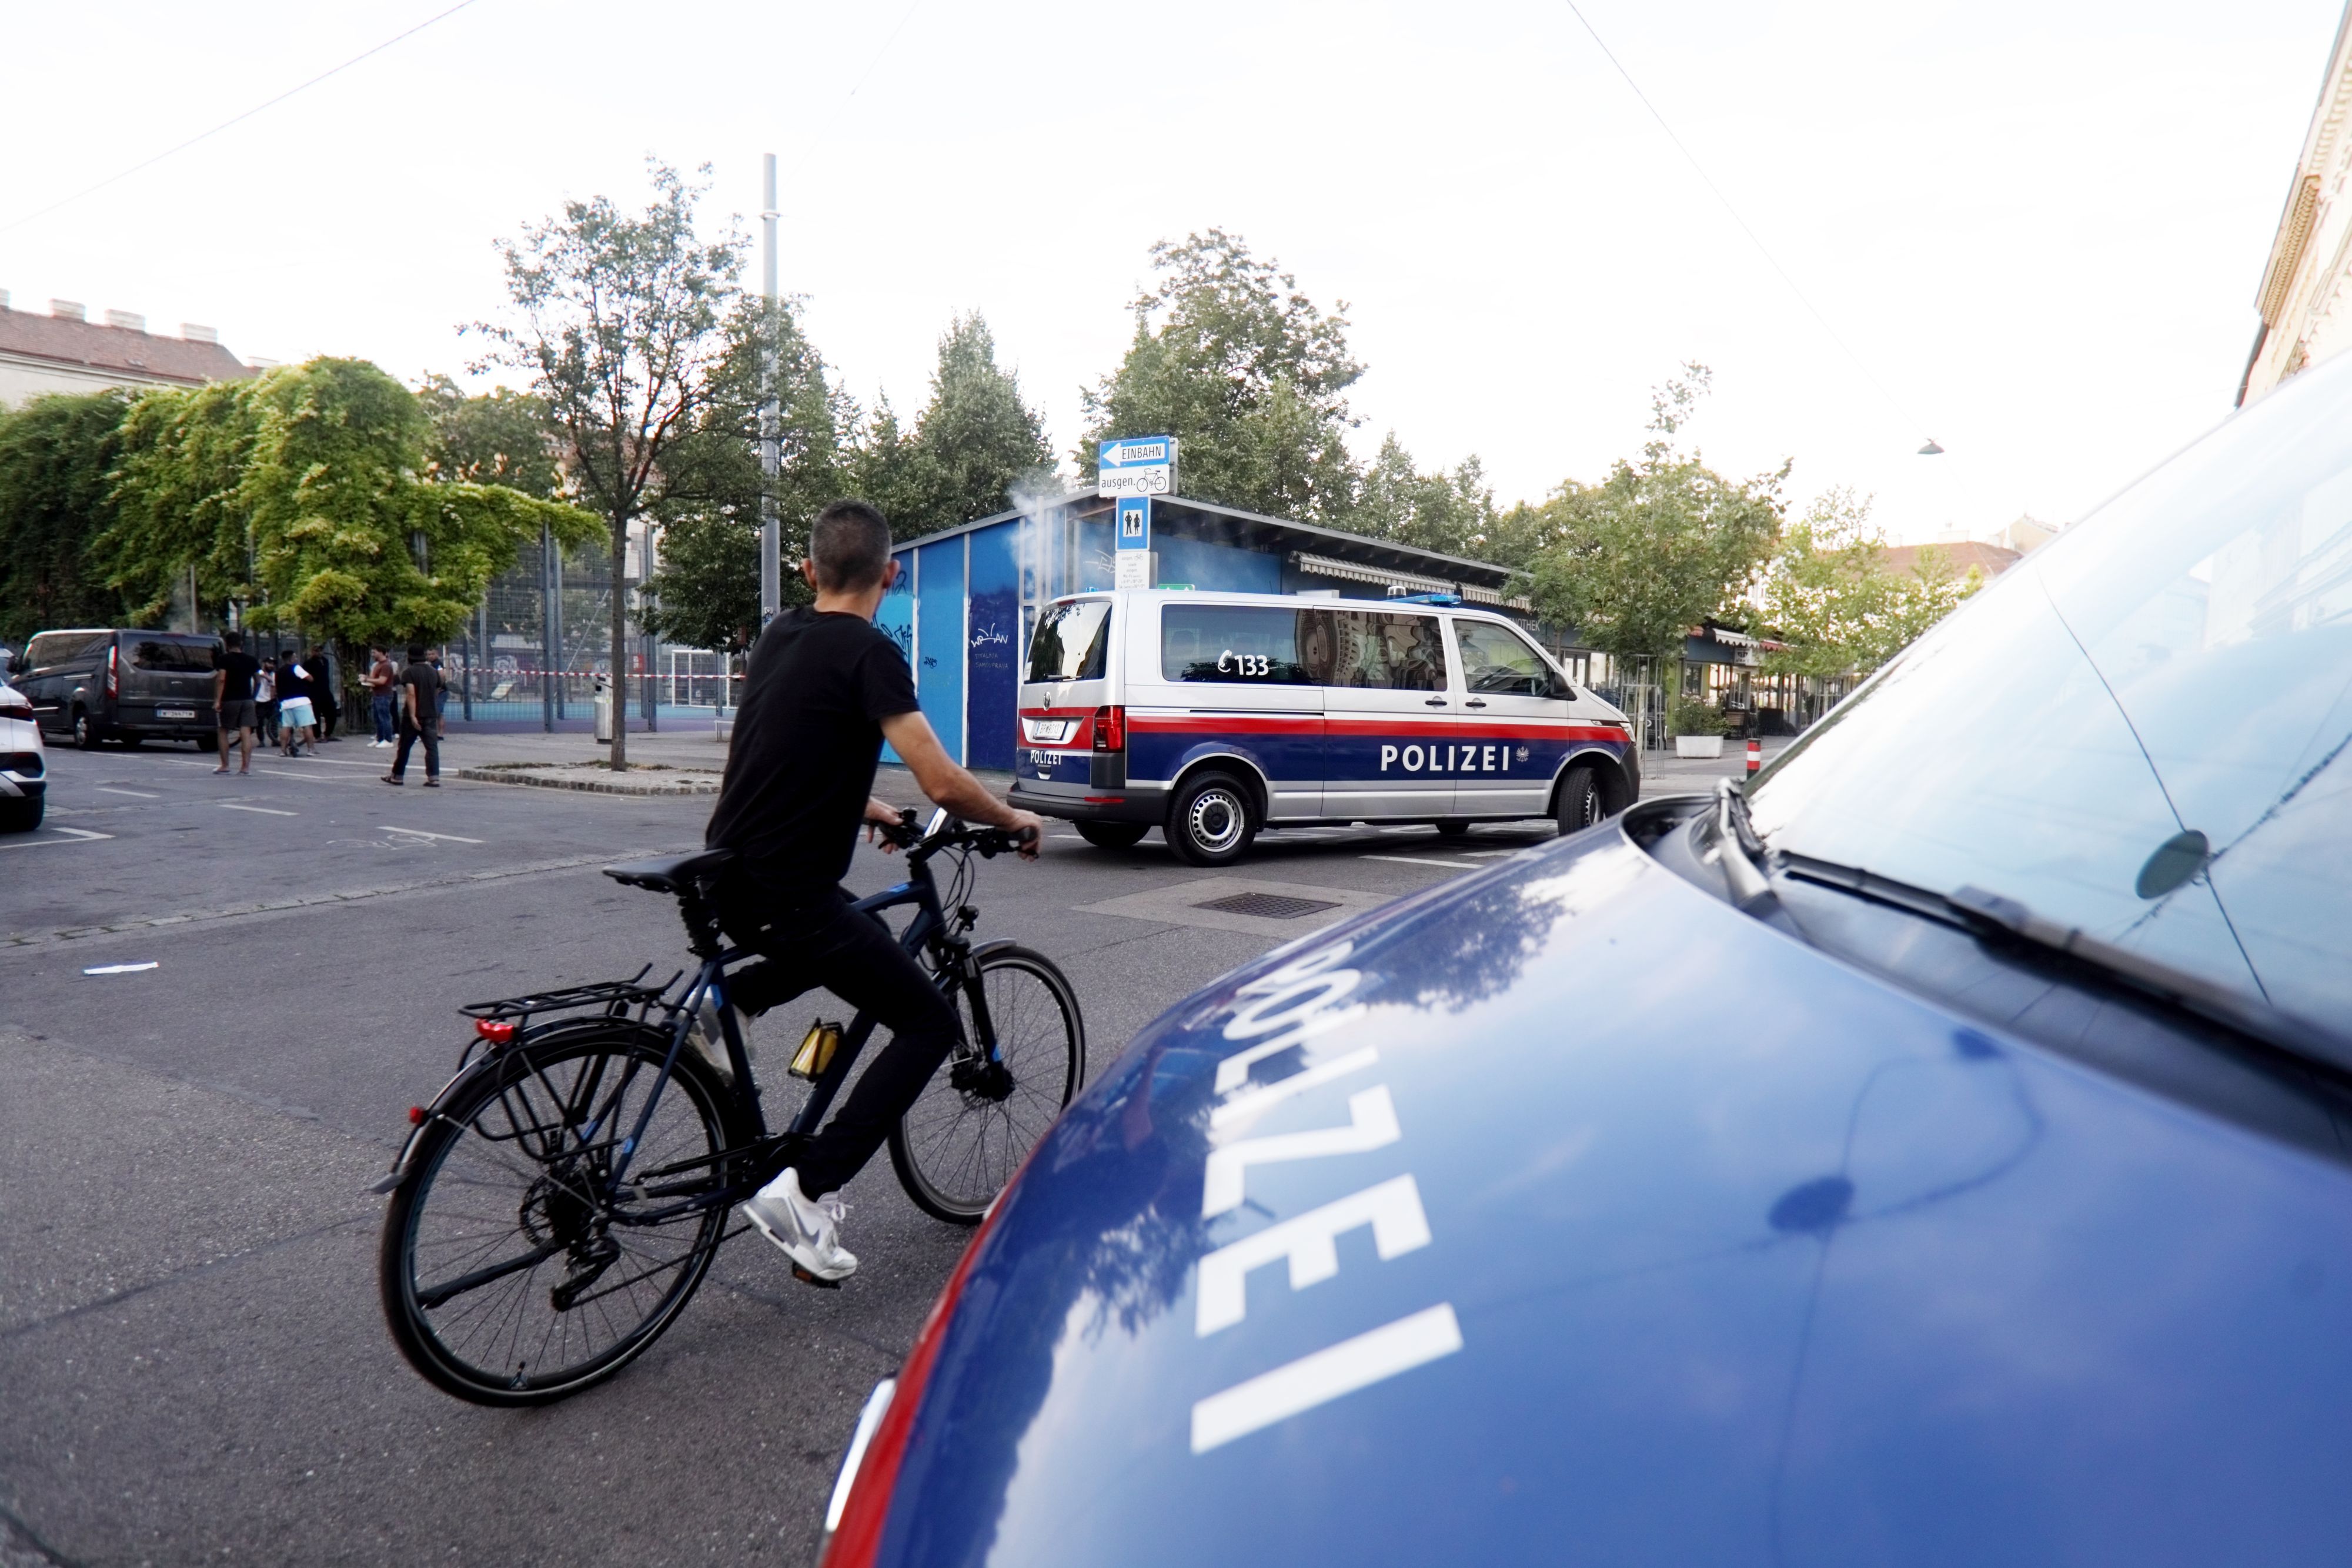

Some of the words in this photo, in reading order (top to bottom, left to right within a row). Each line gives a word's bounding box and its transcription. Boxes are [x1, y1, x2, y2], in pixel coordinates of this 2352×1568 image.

[1122, 446, 1161, 459] EINBAHN
[1101, 477, 1135, 489] ausgen.
[1508, 617, 1542, 631] NOTHEK
[1234, 654, 1269, 676] 133
[1030, 750, 1062, 765] POLIZEI
[1381, 745, 1509, 771] POLIZEI
[1191, 941, 1464, 1456] POLIZEI
